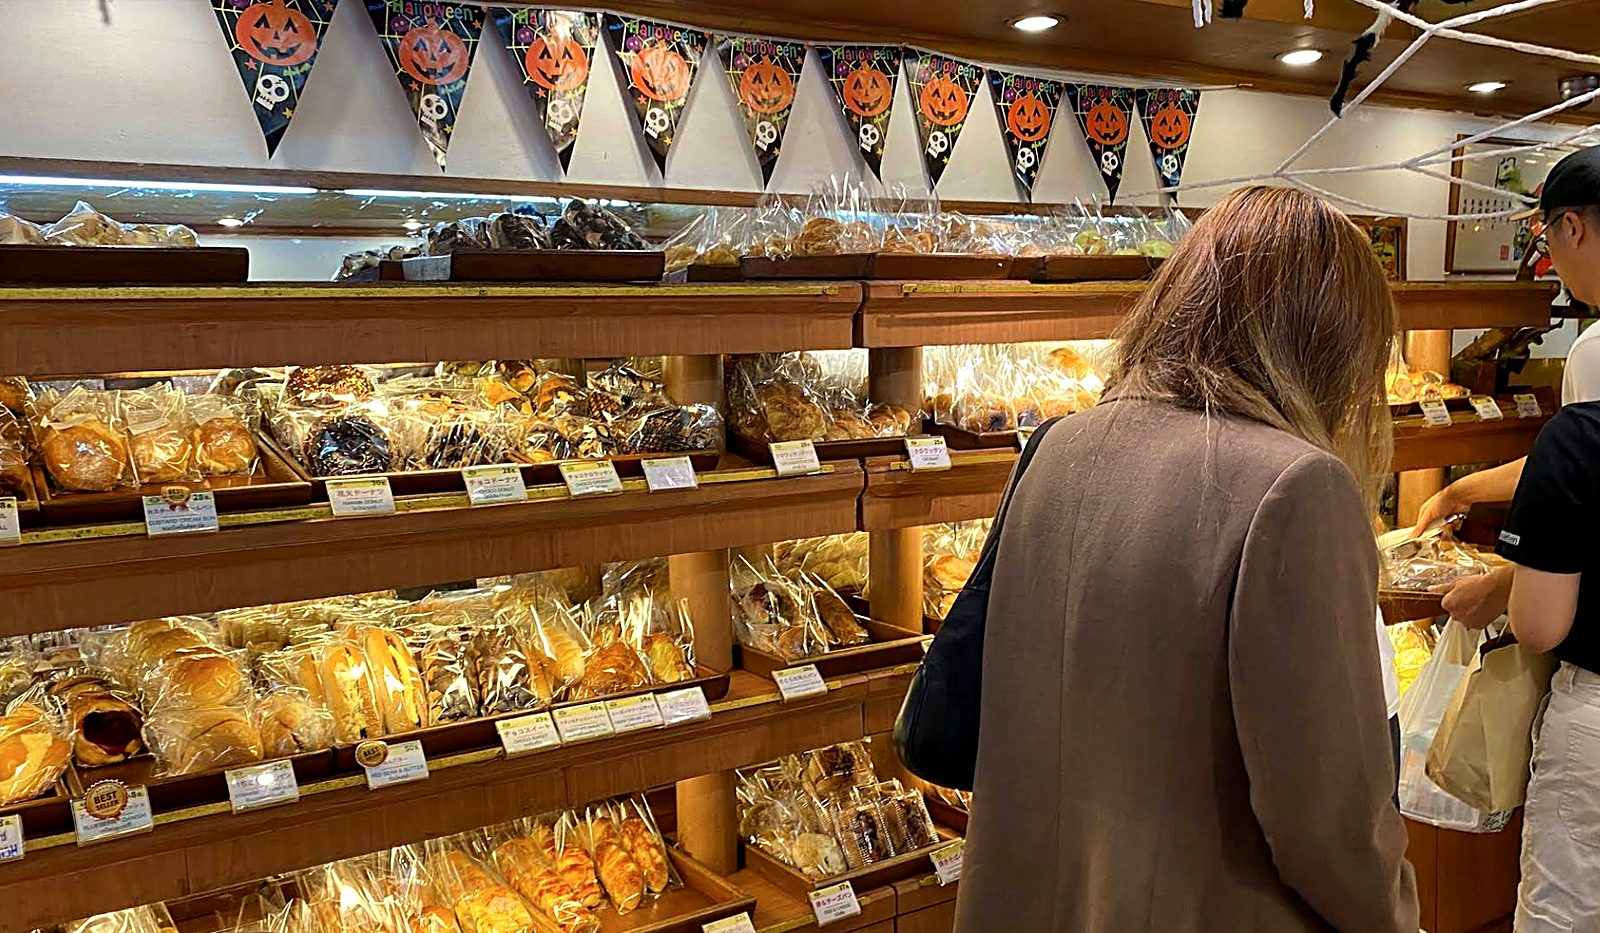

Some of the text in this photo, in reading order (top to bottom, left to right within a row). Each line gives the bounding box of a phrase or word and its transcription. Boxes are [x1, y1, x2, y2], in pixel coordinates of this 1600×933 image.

[392, 1, 473, 21] Halloween
[629, 20, 697, 45] Halloween
[736, 40, 798, 58] Halloween
[837, 47, 894, 61] Halloween
[921, 54, 976, 79] Halloween
[1006, 74, 1056, 94] Halloween
[1080, 84, 1129, 99] Halloween
[1150, 87, 1195, 102] Halloween
[363, 746, 380, 756] BEST
[94, 790, 117, 804] BEST
[96, 800, 119, 811] SELLER
